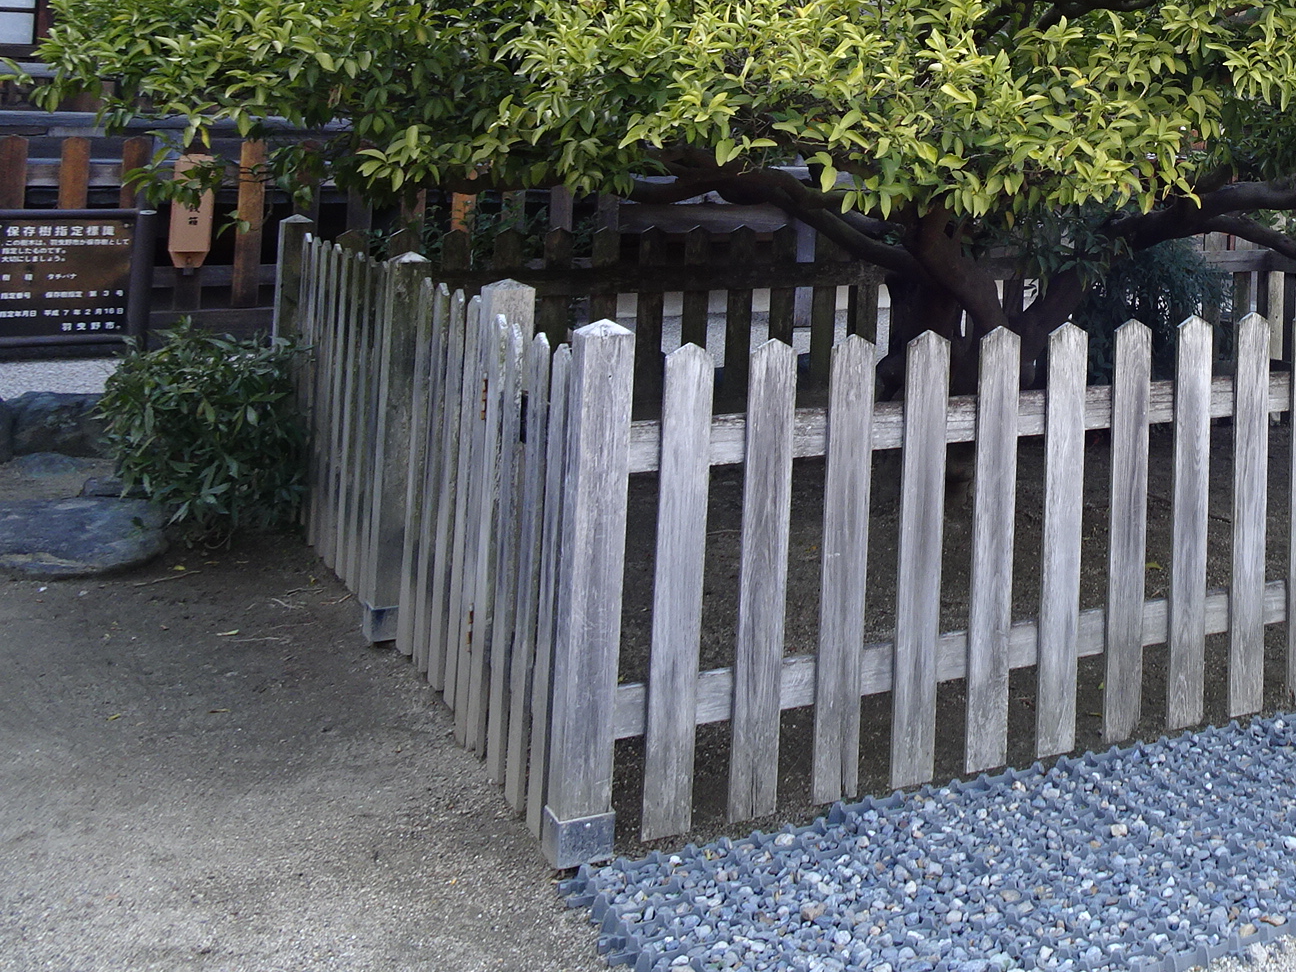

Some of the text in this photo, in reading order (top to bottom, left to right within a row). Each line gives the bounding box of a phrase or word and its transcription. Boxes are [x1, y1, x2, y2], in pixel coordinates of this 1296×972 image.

[6, 226, 116, 237] 保存樹指定標識
[61, 321, 116, 332] 羽曳野市
